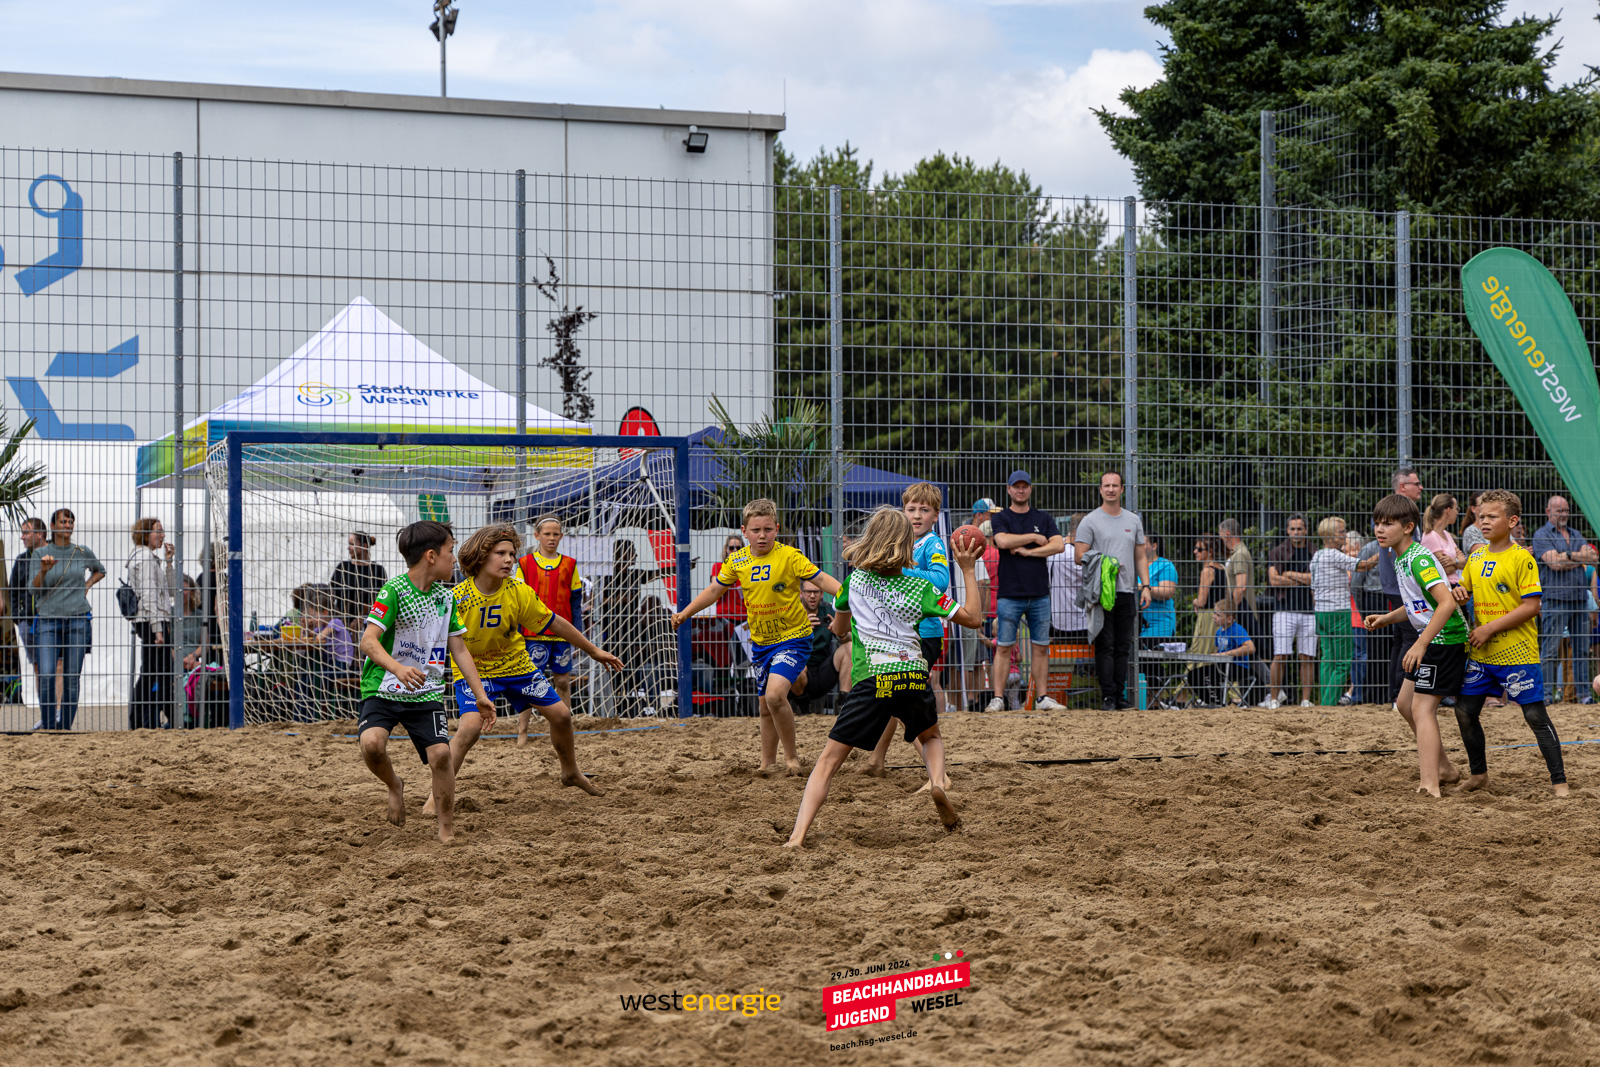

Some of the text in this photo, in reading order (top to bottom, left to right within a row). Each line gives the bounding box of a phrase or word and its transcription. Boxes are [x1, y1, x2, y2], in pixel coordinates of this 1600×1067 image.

[357, 384, 479, 399] Stadtwerke
[361, 395, 428, 405] Wesel
[750, 565, 771, 582] 23
[1481, 561, 1497, 578] 19
[419, 607, 430, 630] 7
[479, 604, 502, 629] 15
[397, 650, 421, 664] Krefeld
[875, 672, 901, 682] Kanal
[521, 683, 535, 695] KFZ
